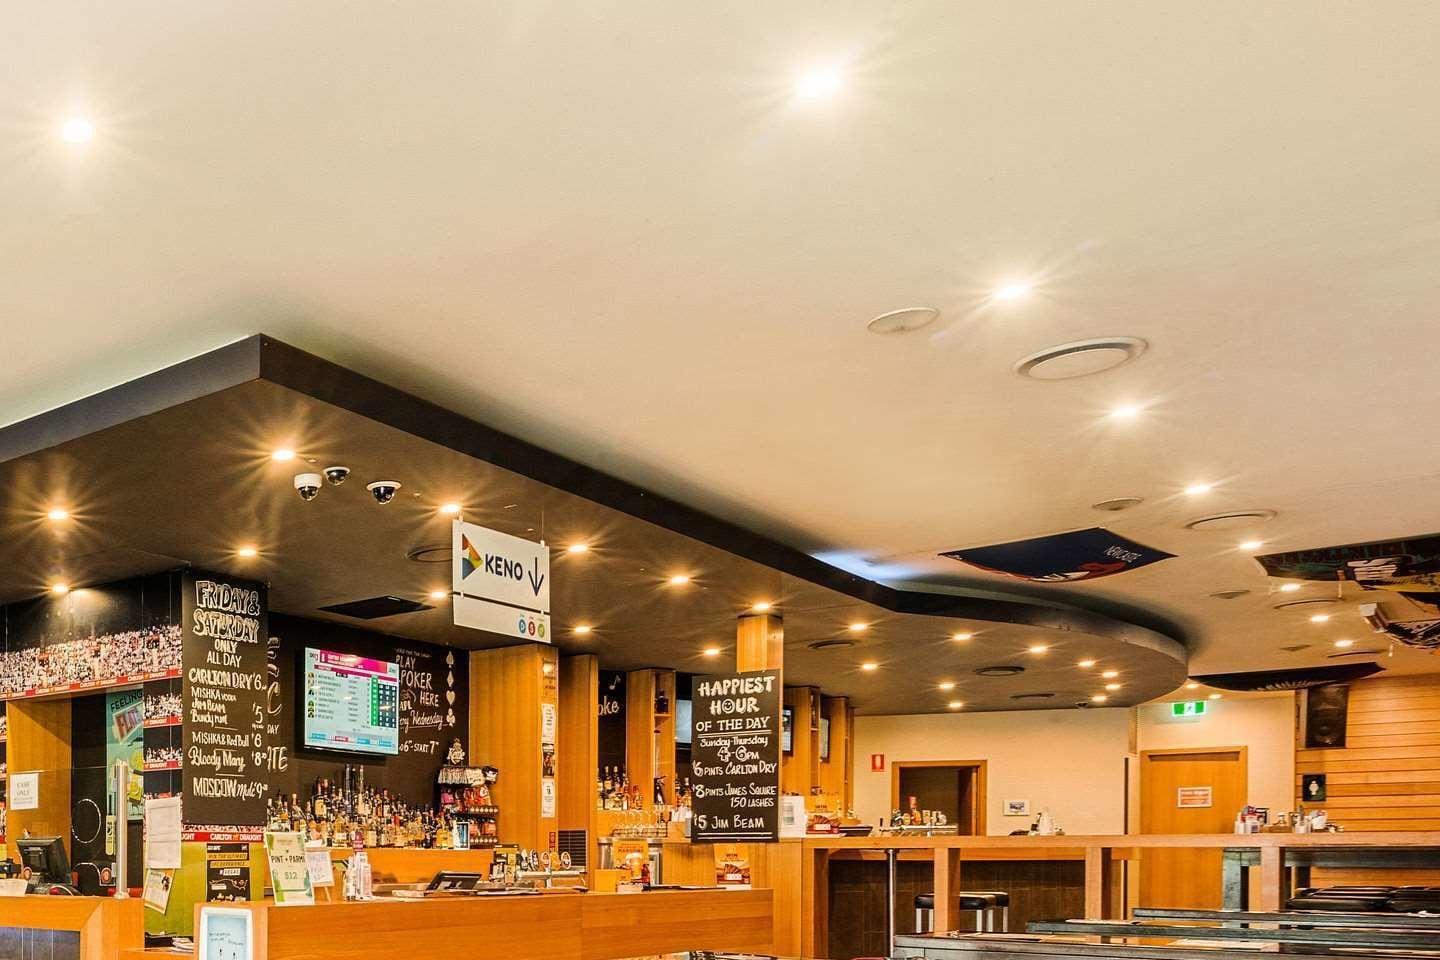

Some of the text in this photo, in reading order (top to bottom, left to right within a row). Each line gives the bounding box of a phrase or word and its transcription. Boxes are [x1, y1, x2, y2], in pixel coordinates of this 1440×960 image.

[485, 553, 523, 581] KENO
[195, 580, 249, 614] FRIDAY
[192, 608, 259, 643] SATURDAY
[214, 638, 238, 654] ONLY
[206, 650, 242, 668] ALL DAY
[188, 667, 231, 687] CARLTON
[231, 672, 253, 689] DRY
[401, 669, 433, 690] POKER
[697, 676, 776, 697] HAPPIEST
[110, 689, 144, 713] FEELING
[191, 686, 221, 701] MISHKA
[420, 690, 440, 707] HERE
[206, 700, 226, 714] BEAM
[709, 696, 761, 715] HOUR
[410, 710, 444, 731] Wednesday
[695, 716, 771, 732] OF THE DAY
[191, 731, 222, 745] MISHKA
[187, 745, 222, 771] Bloody
[222, 750, 246, 772] Mary
[703, 766, 724, 776] PINTS
[725, 761, 759, 775] CARLTON
[758, 760, 777, 774] DRY
[192, 777, 237, 798] MOSCOW
[705, 788, 724, 796] PINTS
[724, 783, 748, 796] JAMES
[748, 782, 777, 796] SQUIRE
[730, 797, 775, 808] 150 LASHES
[711, 816, 729, 829] JIM
[733, 814, 765, 829] BEAM
[239, 833, 262, 841] DRAUGHT
[271, 855, 283, 864] PINT
